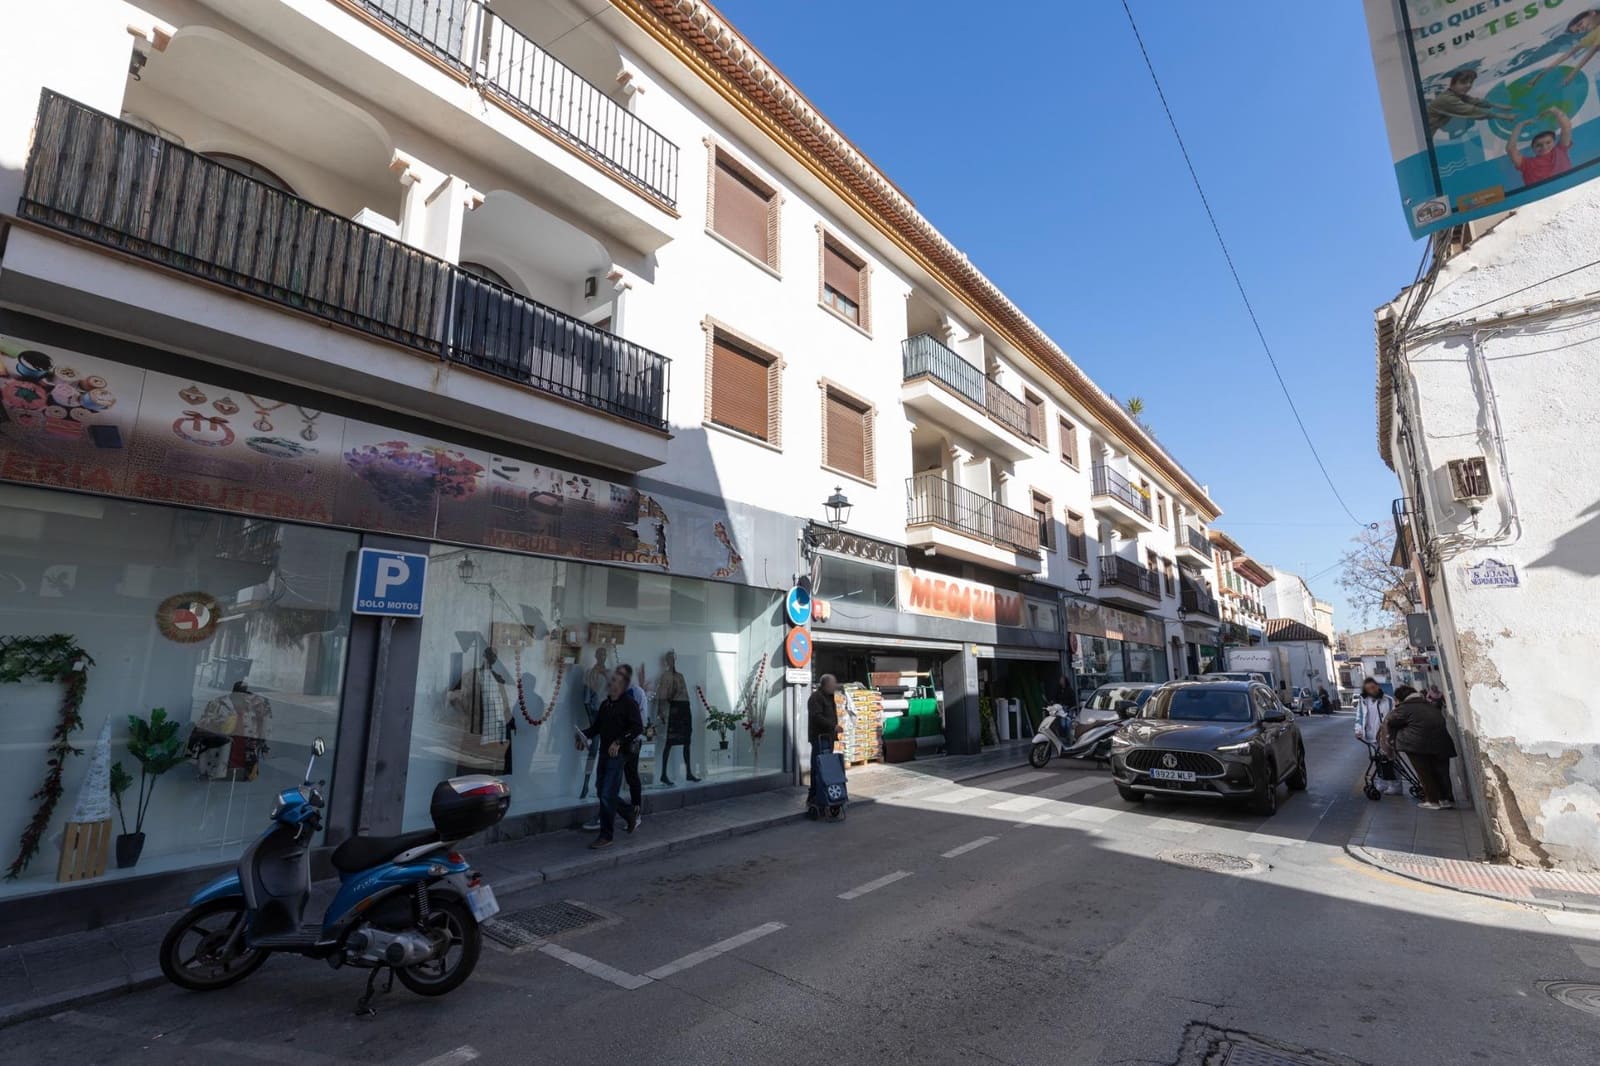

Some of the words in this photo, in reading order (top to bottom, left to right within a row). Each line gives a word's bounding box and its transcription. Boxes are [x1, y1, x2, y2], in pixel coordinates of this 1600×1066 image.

[1420, 22, 1443, 39] LO
[1448, 3, 1487, 27] QUE
[1428, 43, 1446, 57] ES
[1452, 30, 1475, 46] UN
[374, 557, 410, 598] P
[360, 600, 385, 608] SOLO
[387, 601, 419, 610] MOTOS
